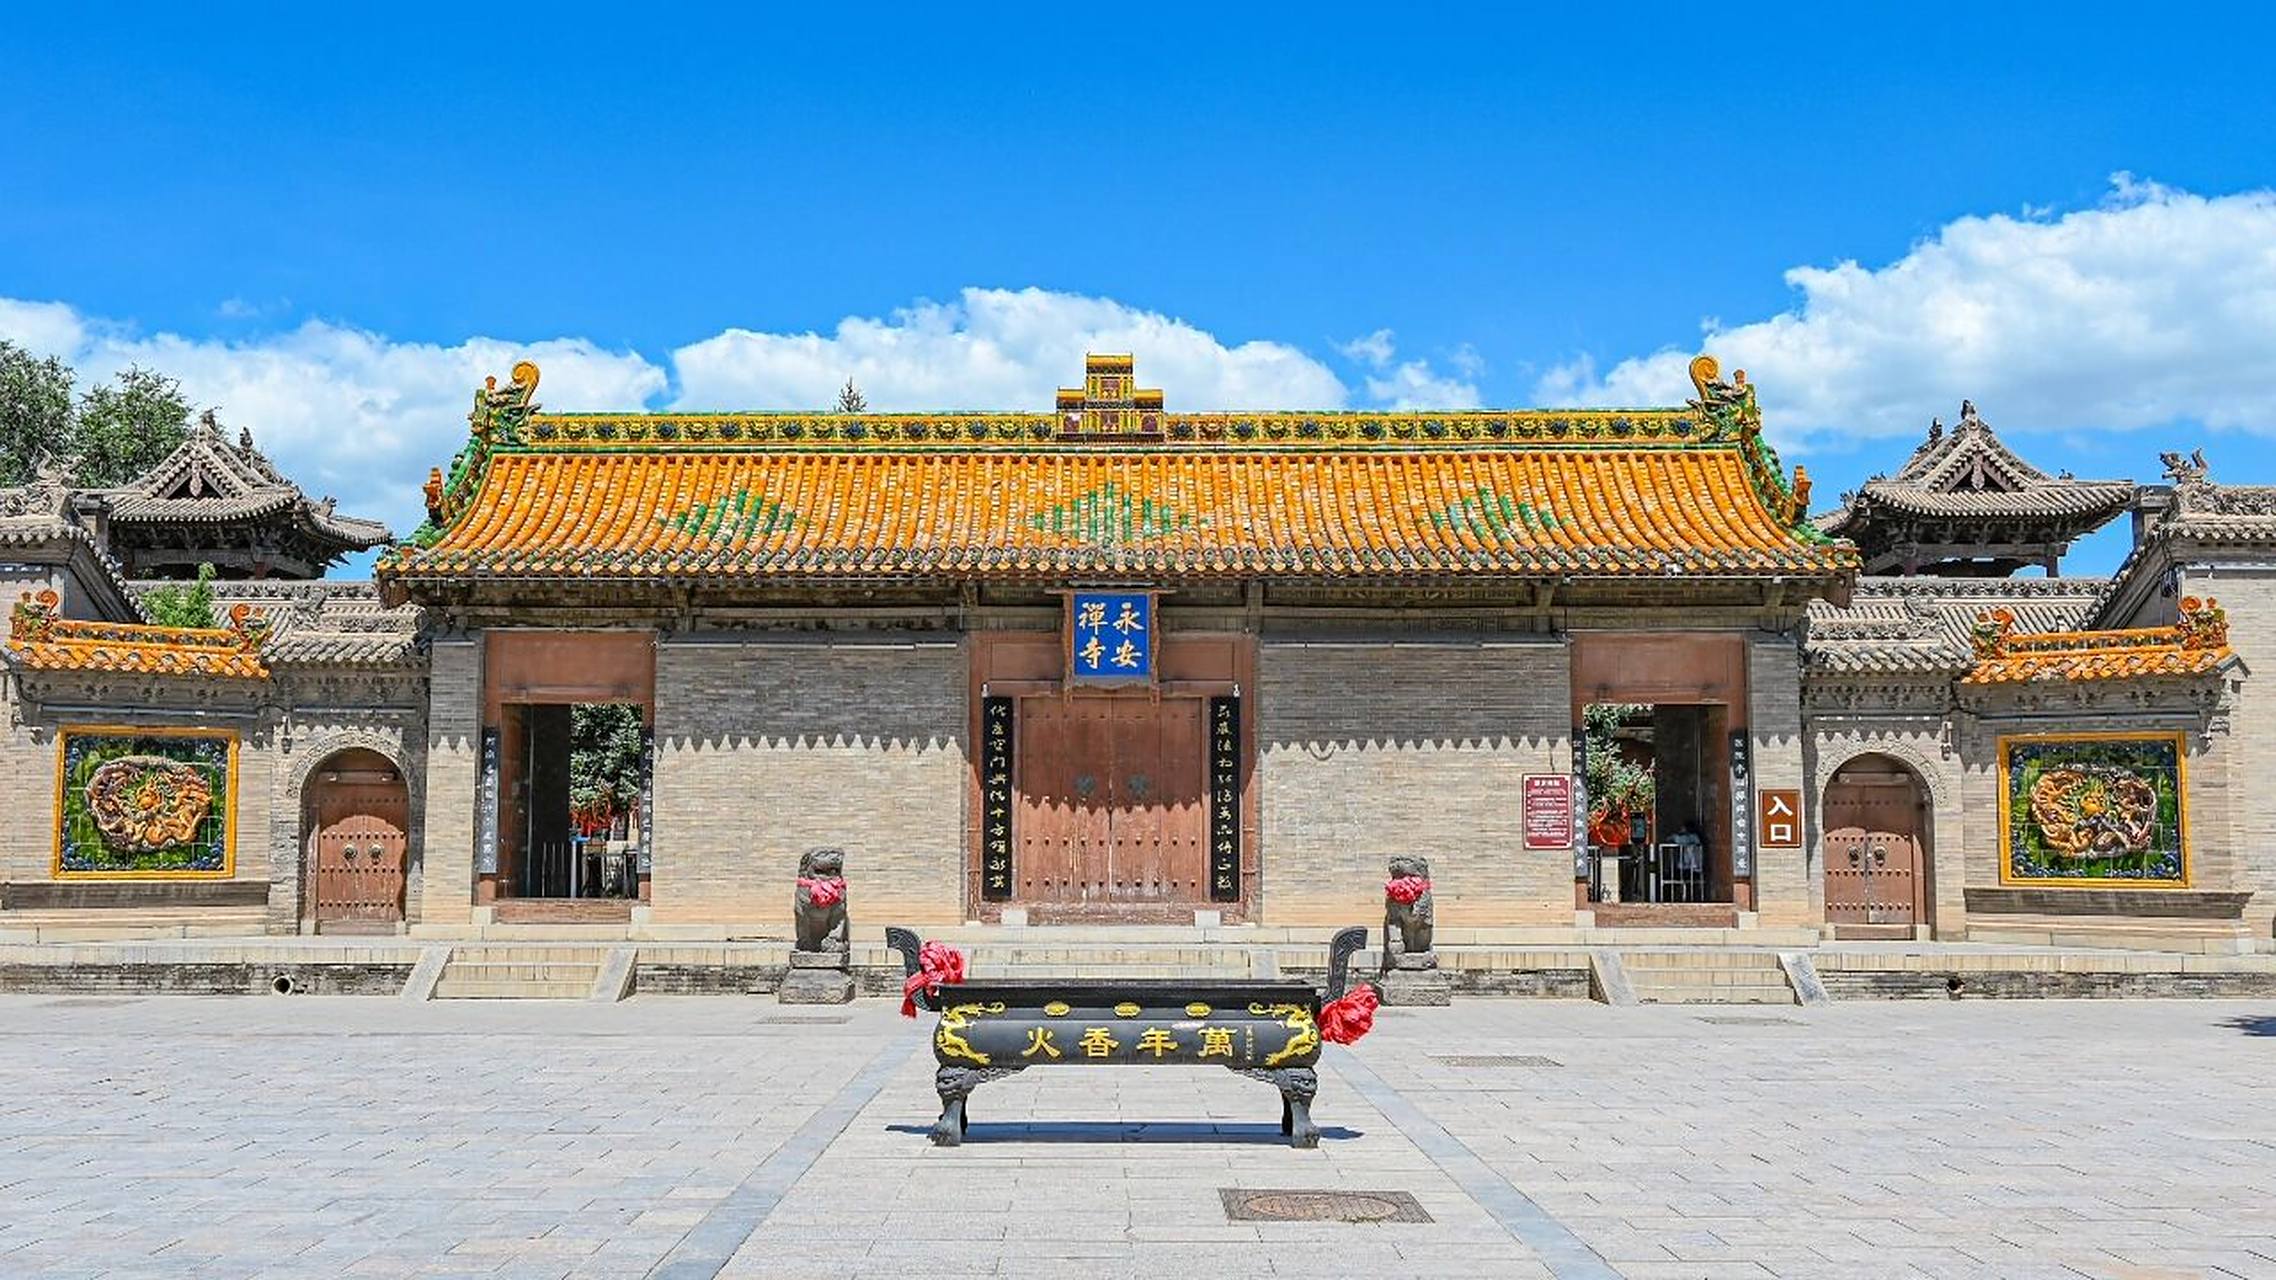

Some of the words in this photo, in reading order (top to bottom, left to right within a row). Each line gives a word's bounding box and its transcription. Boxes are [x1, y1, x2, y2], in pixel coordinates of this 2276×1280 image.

[1079, 602, 1108, 669] 禪寺
[1111, 602, 1145, 668] 永安
[1767, 796, 1793, 842] 入口
[1022, 1026, 1238, 1059] 萬年香火
